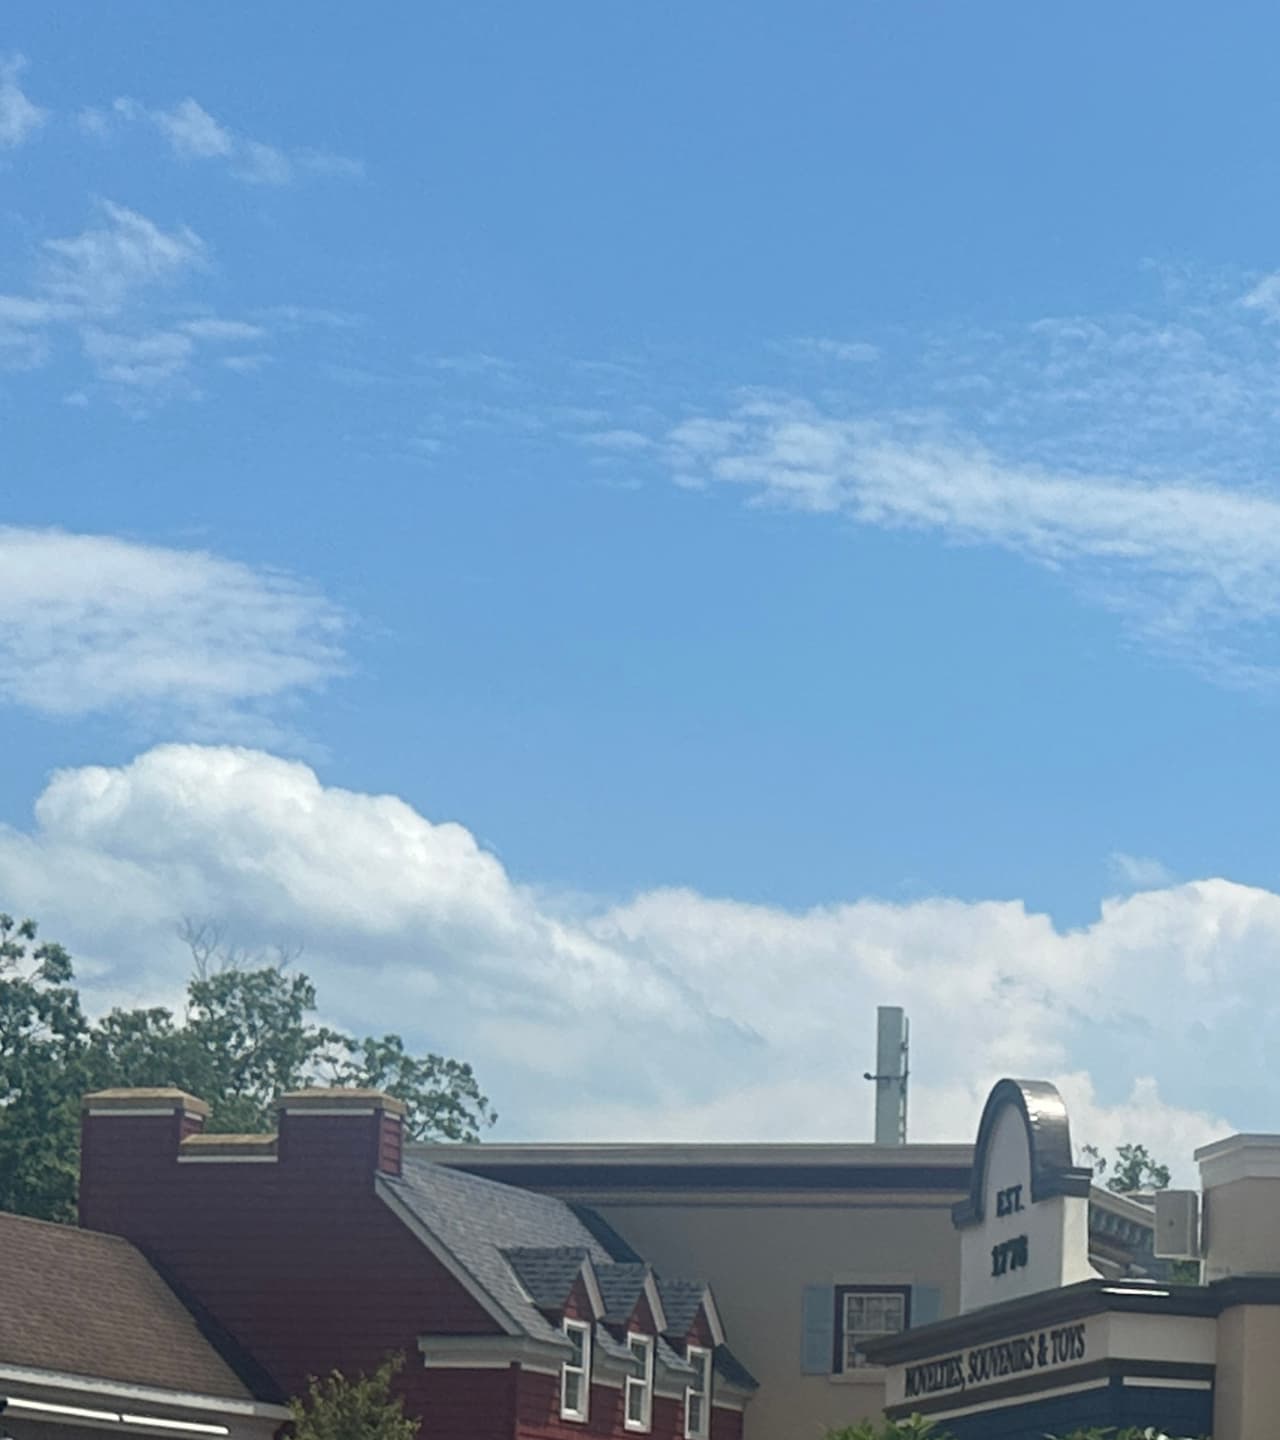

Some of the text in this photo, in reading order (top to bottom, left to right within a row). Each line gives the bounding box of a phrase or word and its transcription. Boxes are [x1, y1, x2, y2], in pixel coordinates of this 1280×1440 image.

[995, 1184, 1025, 1217] EST.
[904, 1323, 1086, 1398] NOVELTIES, SOUVENIRS & TOYS
